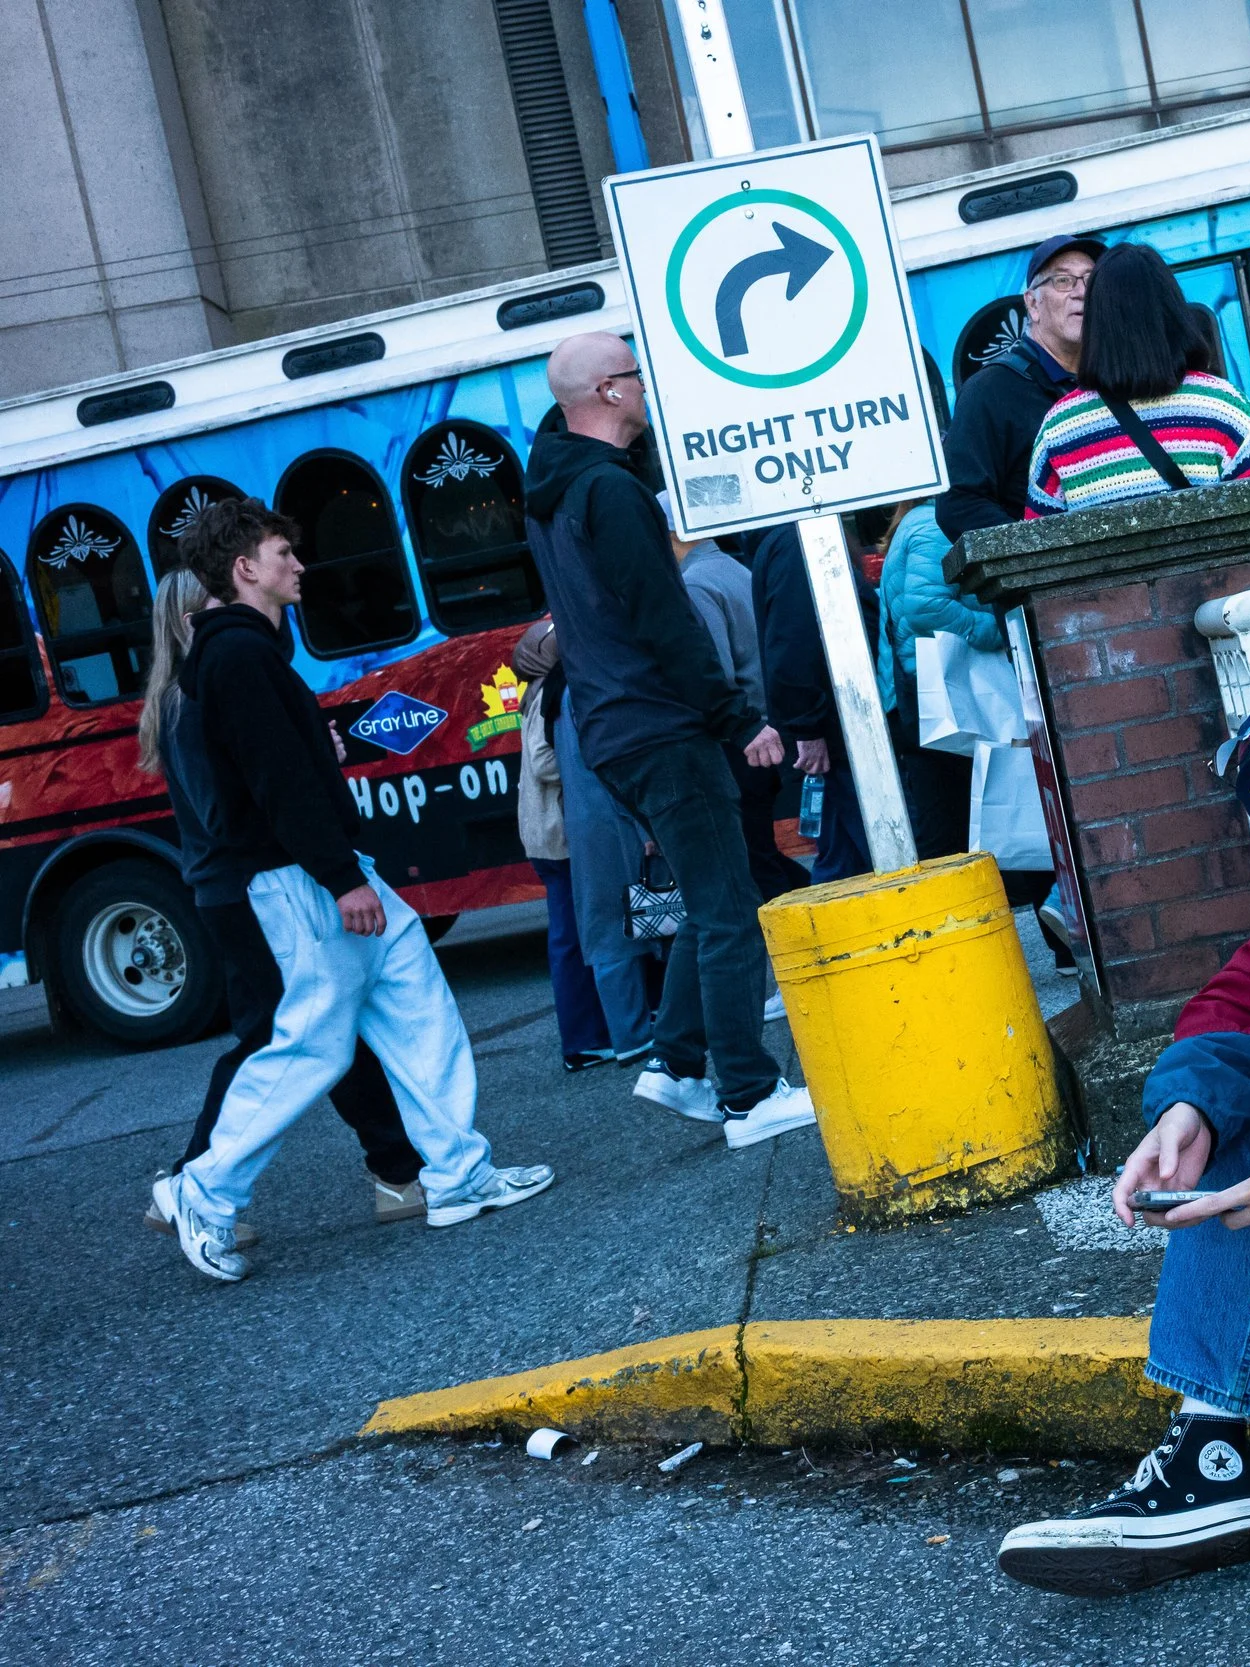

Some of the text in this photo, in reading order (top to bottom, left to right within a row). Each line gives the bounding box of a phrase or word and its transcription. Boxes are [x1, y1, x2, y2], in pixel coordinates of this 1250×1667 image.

[682, 393, 910, 461] RIGHT TURN
[754, 441, 853, 484] ONLY
[358, 709, 439, 736] Gray Line
[348, 760, 508, 824] Hop-on
